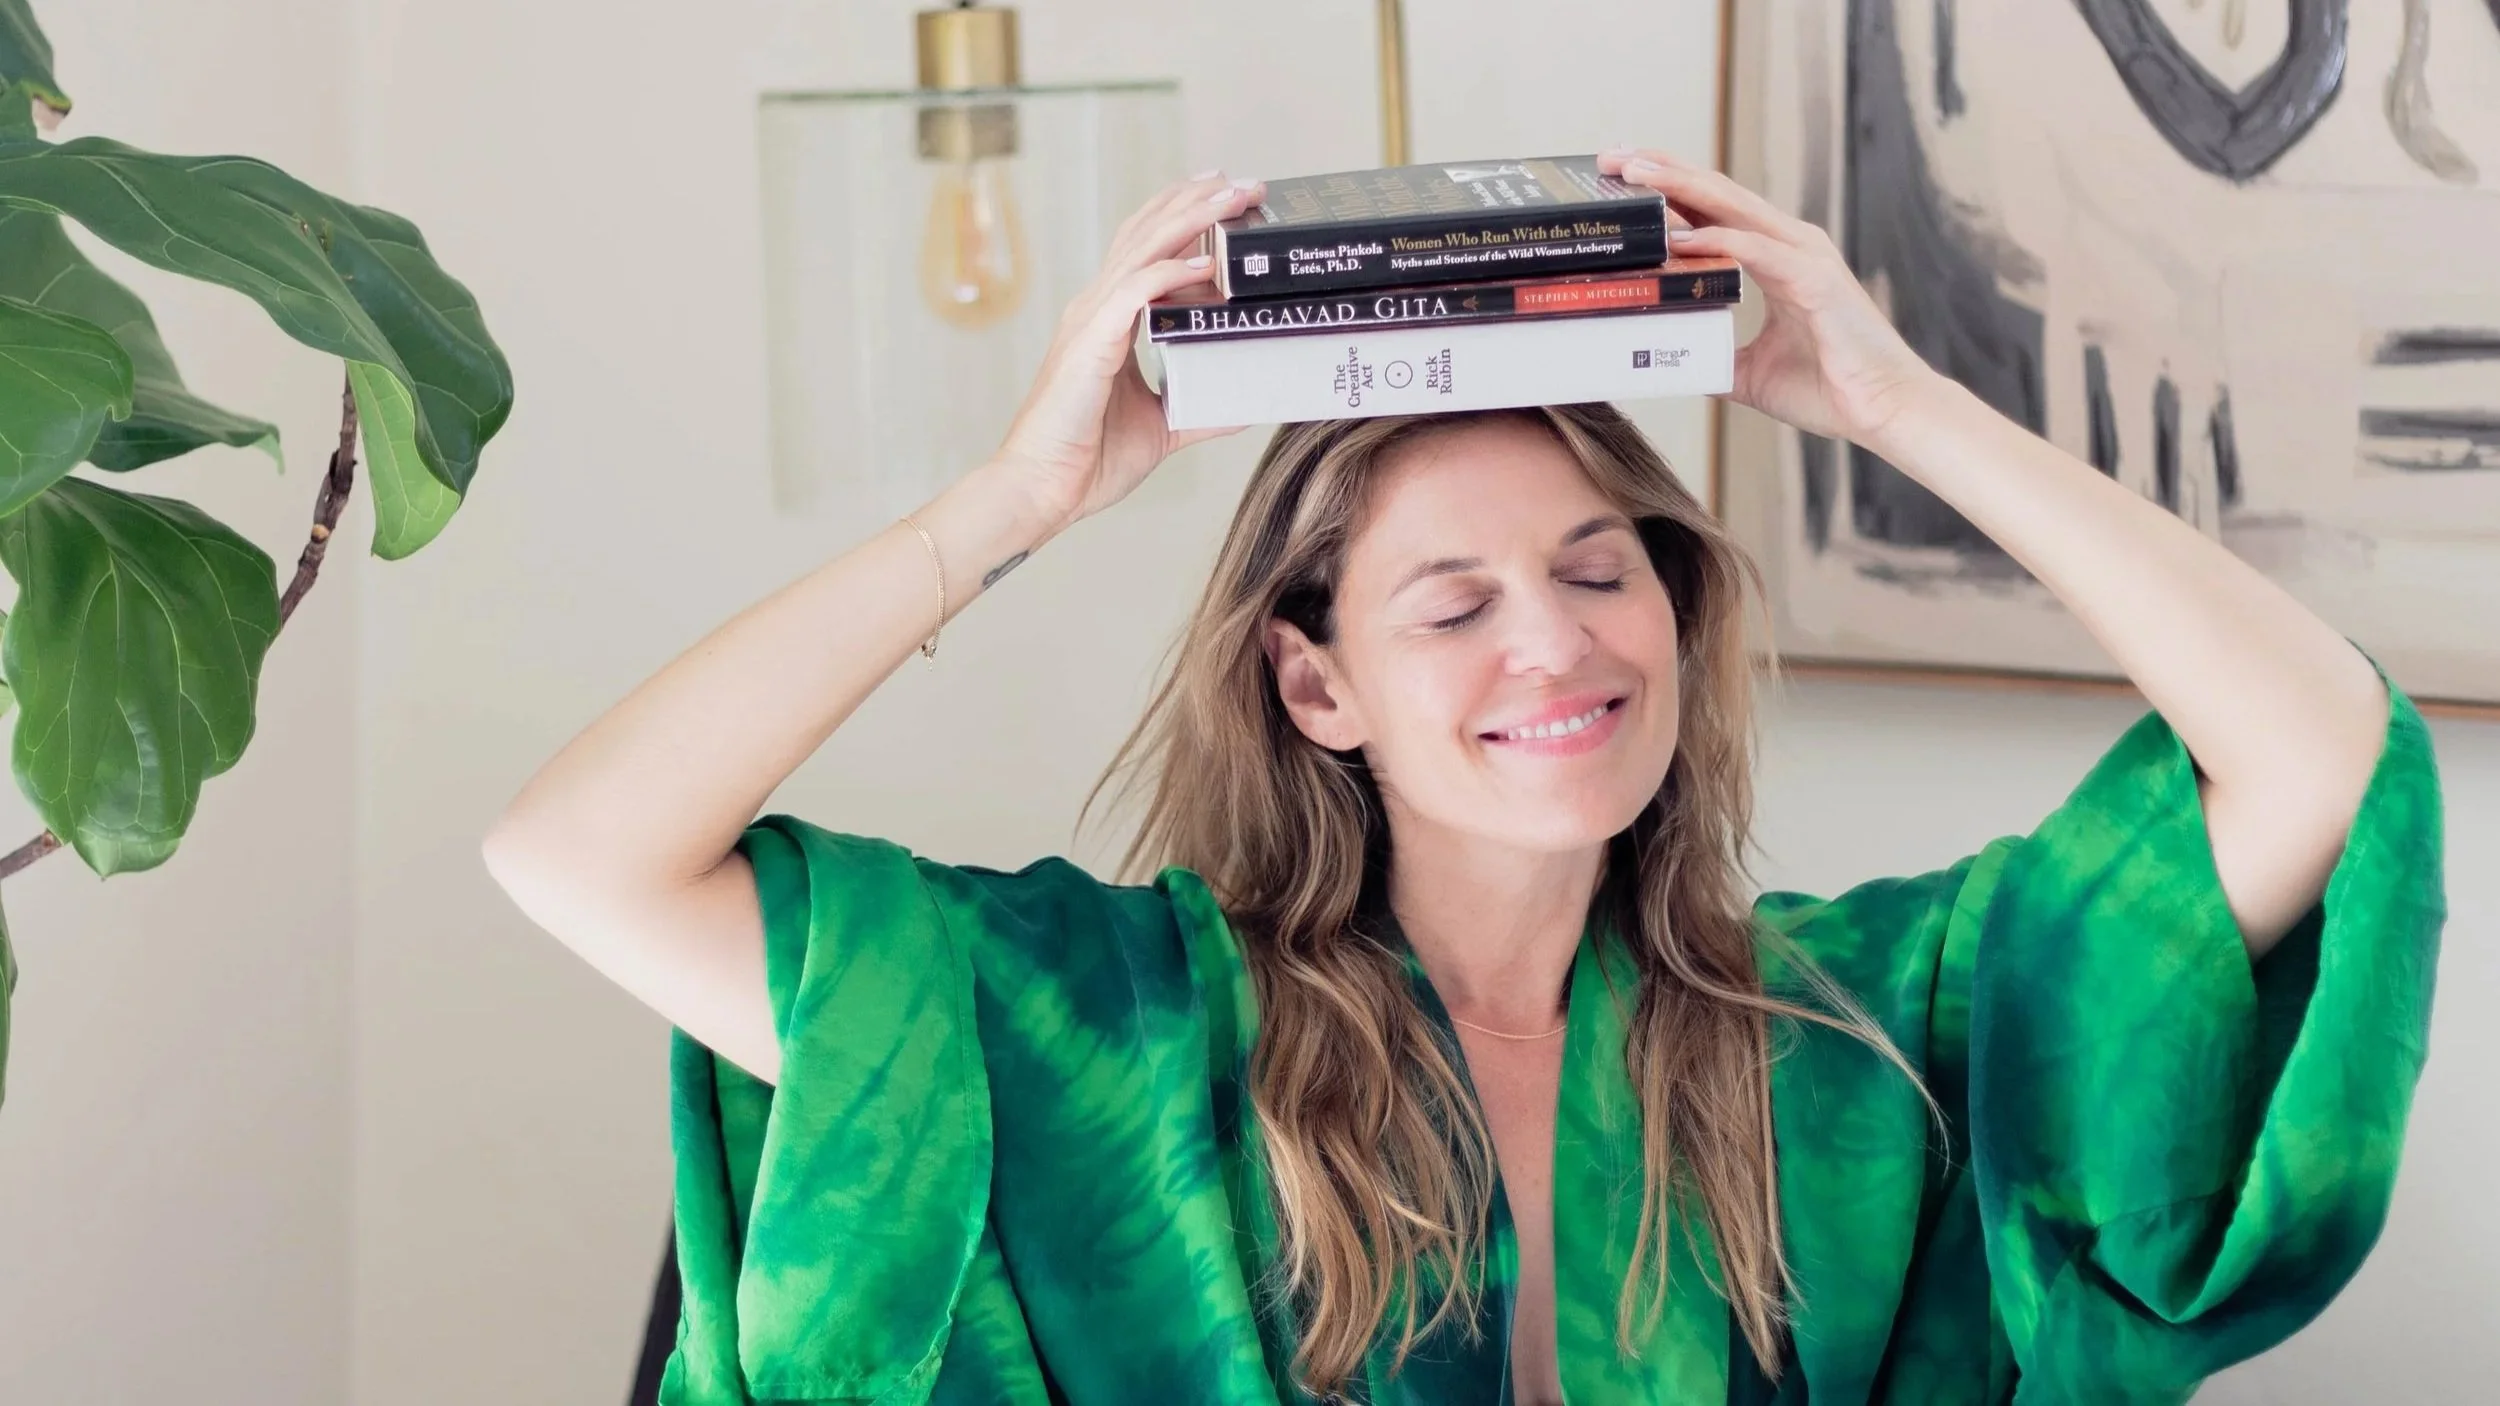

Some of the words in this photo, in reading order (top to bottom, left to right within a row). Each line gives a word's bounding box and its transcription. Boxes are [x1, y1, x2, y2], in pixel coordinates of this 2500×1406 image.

[1391, 237, 1442, 251] Women
[1446, 233, 1478, 247] Who
[1482, 230, 1510, 245] Run
[1512, 226, 1547, 241] With
[1550, 225, 1571, 238] the
[1573, 222, 1621, 236] Wolves
[1289, 248, 1336, 261] Clarissa
[1338, 243, 1383, 257] Pinkola
[1391, 257, 1422, 270] Myths
[1424, 254, 1442, 266] and
[1444, 252, 1478, 265] Stories
[1479, 250, 1491, 262] of
[1491, 250, 1507, 261] the
[1508, 246, 1533, 259] Wild
[1535, 245, 1573, 257] Woman
[1574, 241, 1623, 254] Archetype
[1290, 262, 1325, 276] Estés,
[1327, 259, 1362, 272] Ph.D.
[1524, 290, 1579, 304] STEPHEN
[1586, 286, 1650, 300] MITCHELL
[1189, 303, 1356, 332] BHAGAVAD
[1374, 296, 1449, 319] GITA
[1655, 348, 1690, 360] Penguin
[1655, 359, 1680, 368] Press
[1334, 364, 1346, 394] The
[1347, 345, 1361, 408] Creative
[1361, 364, 1374, 390] Act
[1425, 355, 1438, 390] Rick
[1439, 347, 1452, 395] Rubin
